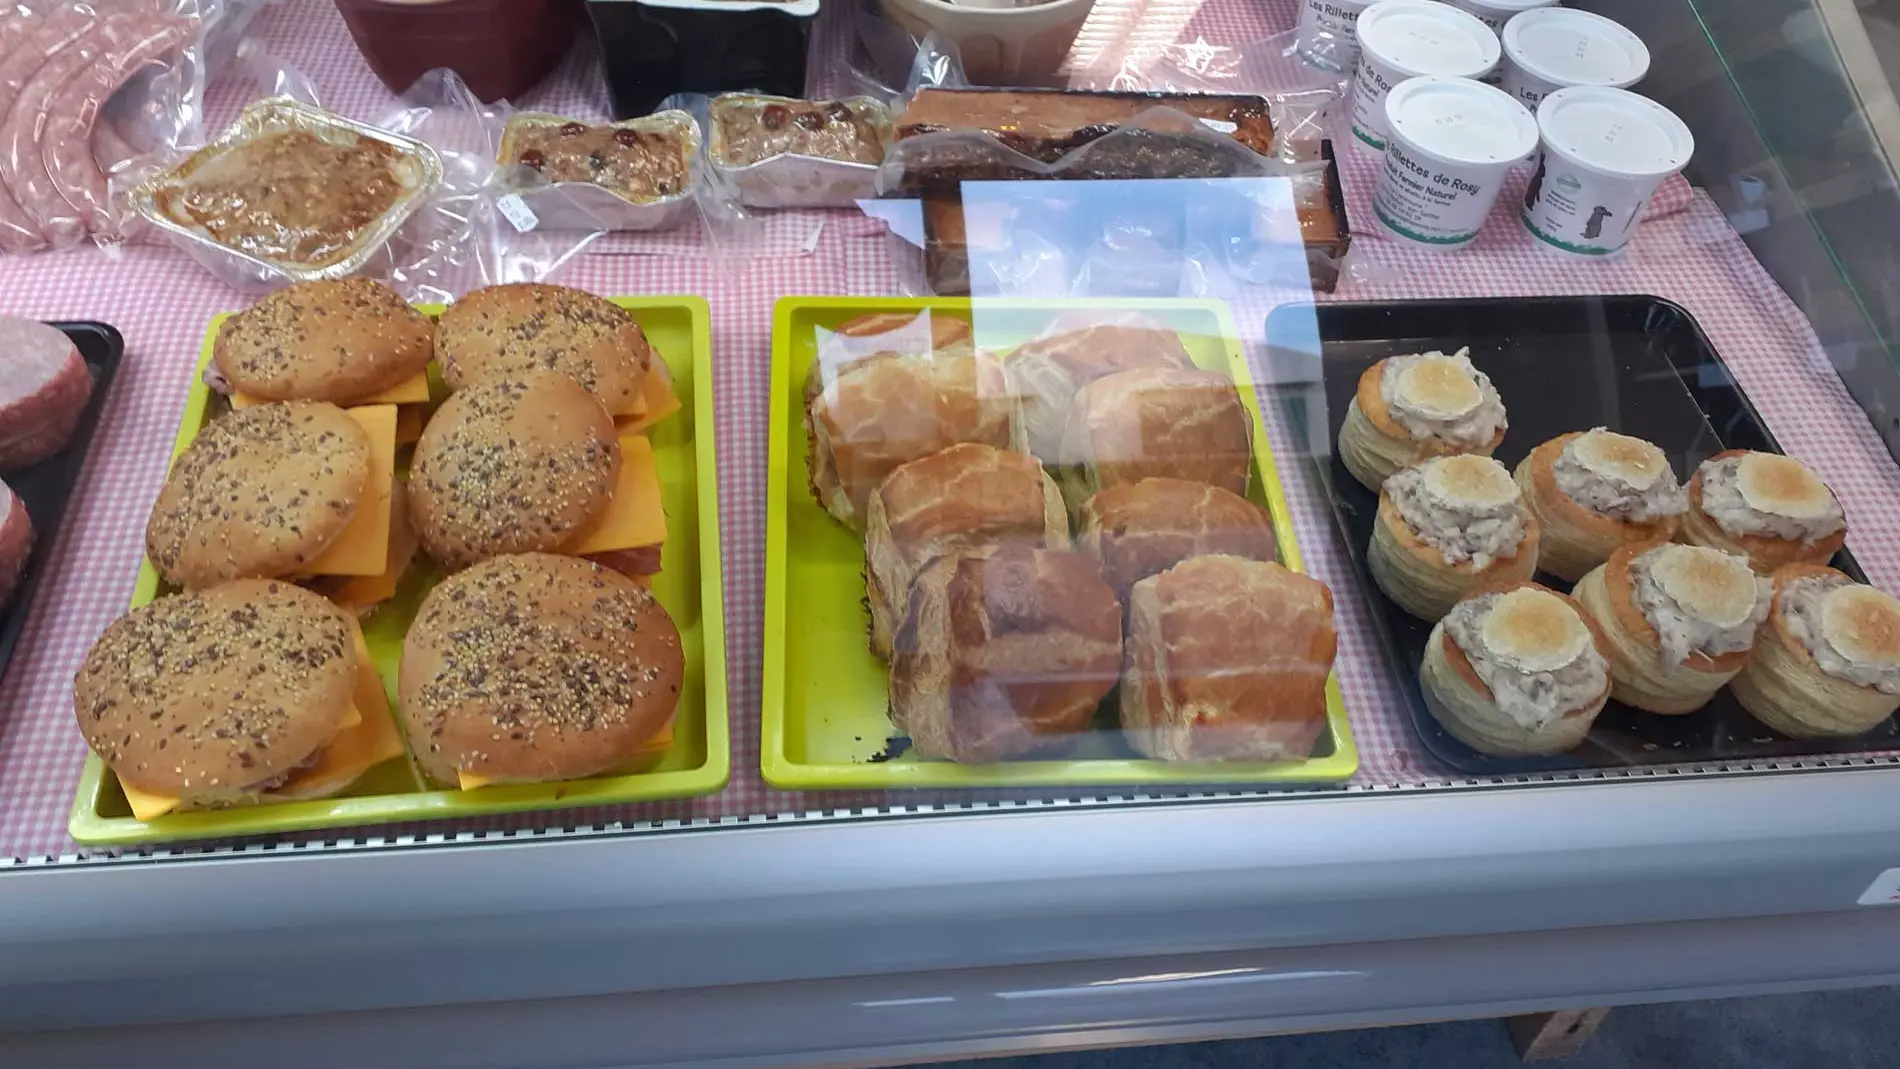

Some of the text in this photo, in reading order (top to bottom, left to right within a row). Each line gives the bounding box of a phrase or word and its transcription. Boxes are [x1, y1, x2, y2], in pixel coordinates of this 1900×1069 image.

[1520, 86, 1538, 101] Les
[1433, 173, 1450, 186] de
[1451, 178, 1481, 196] Rosy
[1425, 186, 1458, 201] Naturel
